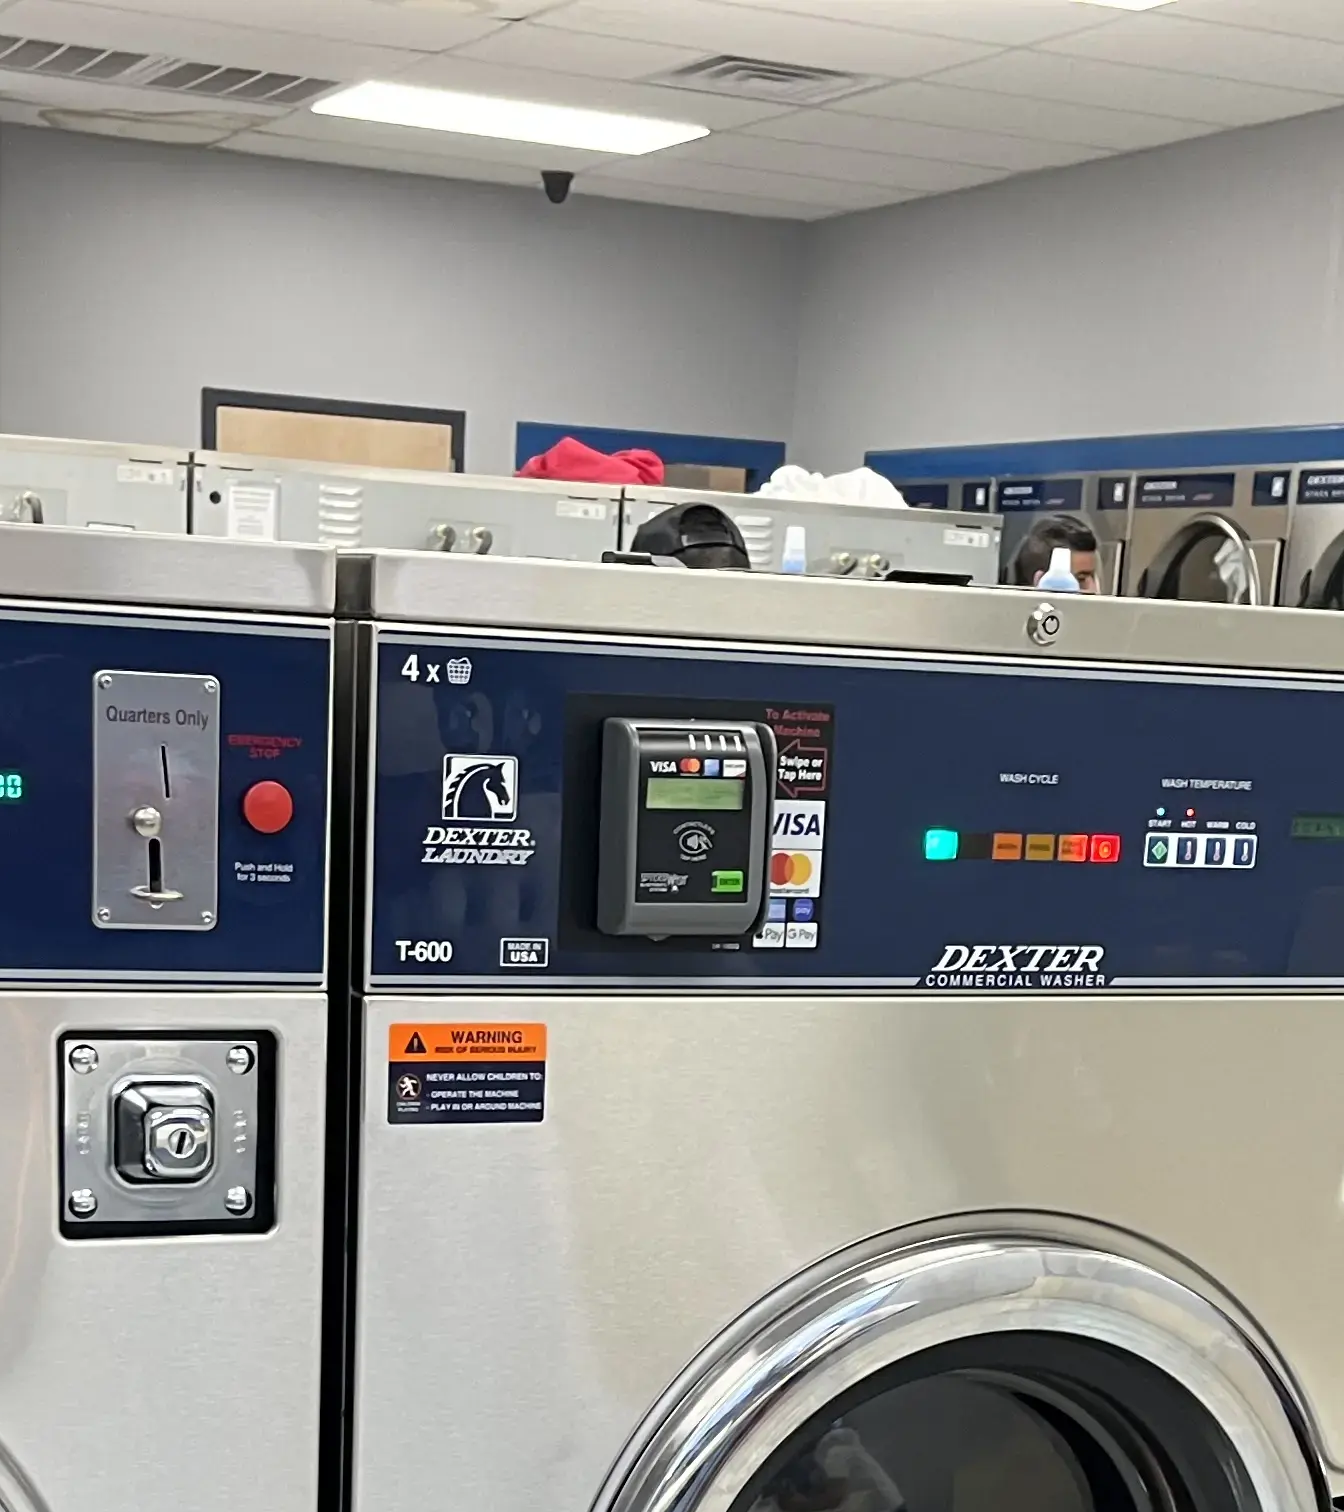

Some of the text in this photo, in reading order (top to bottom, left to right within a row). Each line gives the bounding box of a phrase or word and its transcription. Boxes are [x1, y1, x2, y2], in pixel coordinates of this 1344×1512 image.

[401, 654, 440, 684] 4 x
[106, 705, 209, 730] Quarters Only
[227, 734, 303, 748] EMERGENCY
[248, 748, 281, 759] STOP
[650, 760, 677, 773] VISA
[780, 755, 824, 770] Swipe or
[778, 768, 822, 782] Tap Here
[1000, 773, 1059, 784] WASH CYCLE
[1162, 778, 1253, 790] WASH TEMPERATURE
[422, 826, 528, 847] DEXTER
[420, 848, 536, 866] LAUNDRY
[234, 862, 256, 872] Push
[257, 862, 273, 872] and
[236, 872, 291, 882] for 3 seconds
[395, 940, 452, 962] T-600
[510, 951, 538, 964] USA
[931, 944, 1105, 972] DEXTER
[925, 974, 1106, 986] COMMERCIAL WASHER
[450, 1030, 522, 1044] WARNING
